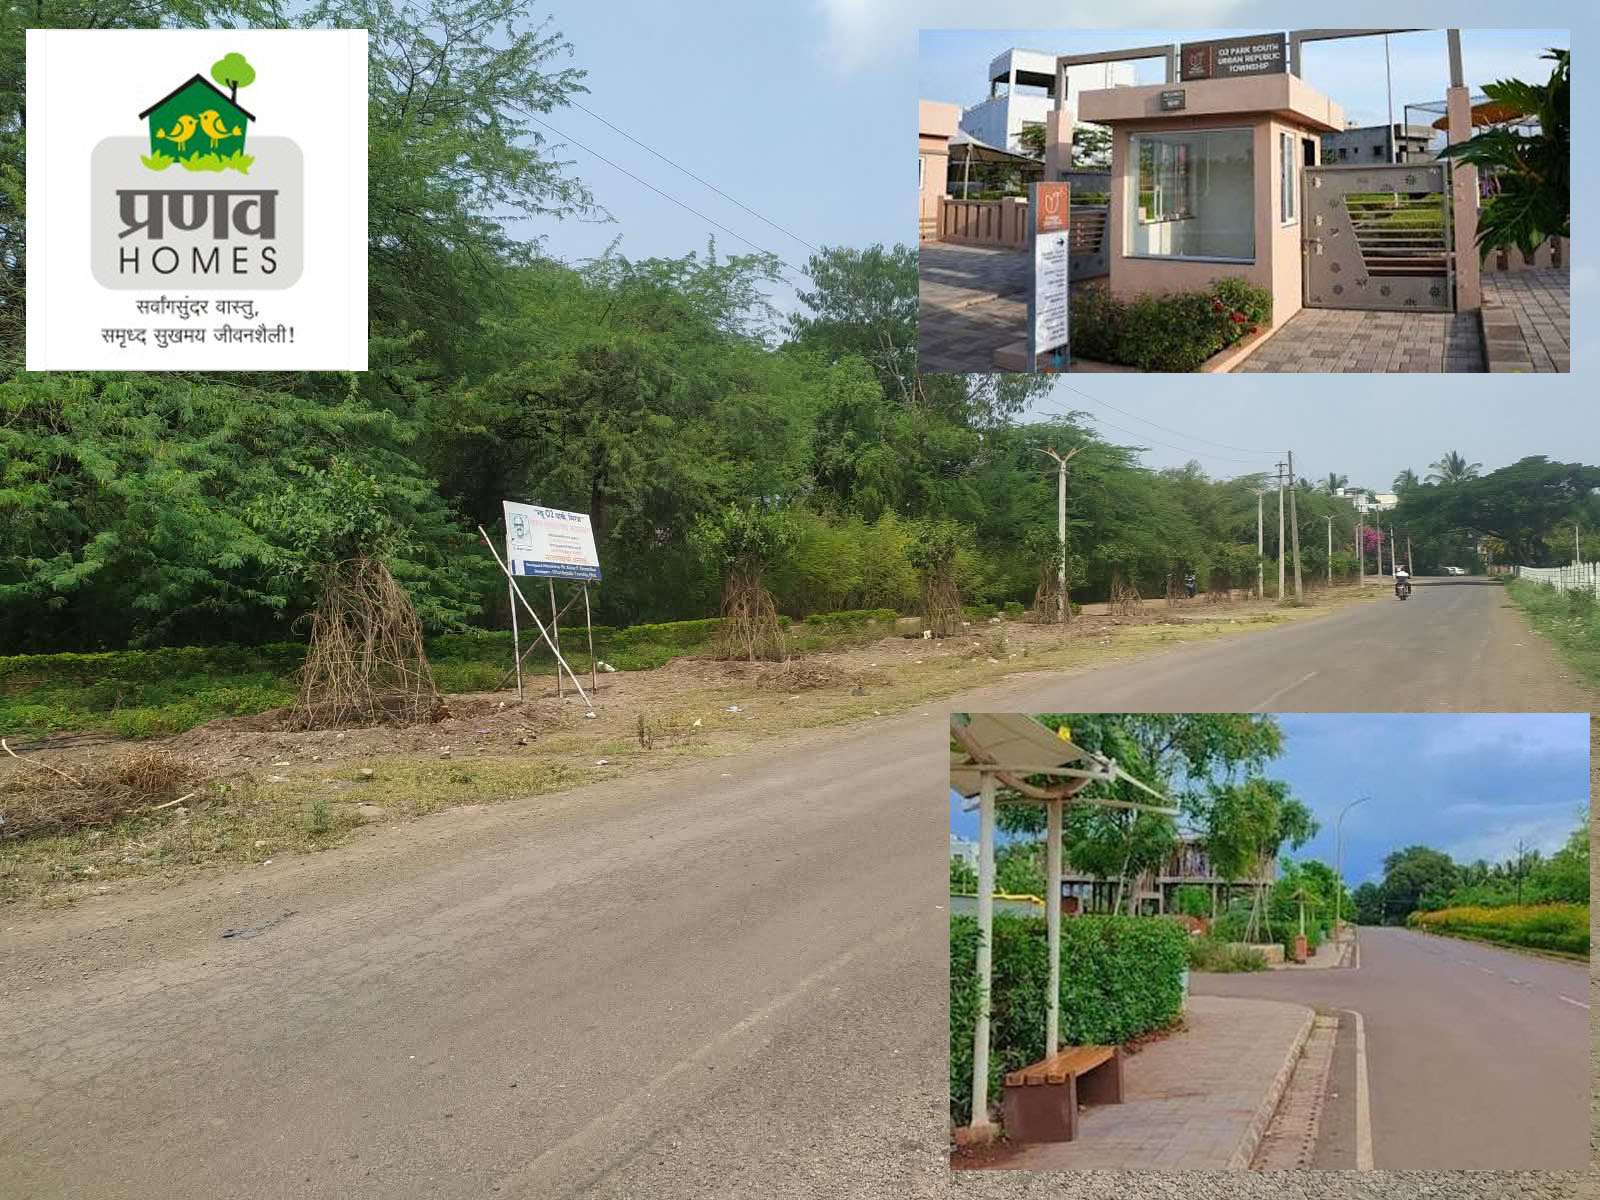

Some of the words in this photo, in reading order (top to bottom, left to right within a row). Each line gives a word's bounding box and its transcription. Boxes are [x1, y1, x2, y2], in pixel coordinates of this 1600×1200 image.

[1230, 46, 1250, 55] PARK
[1252, 43, 1279, 53] SOUTH
[1244, 52, 1281, 62] REPUBLIC
